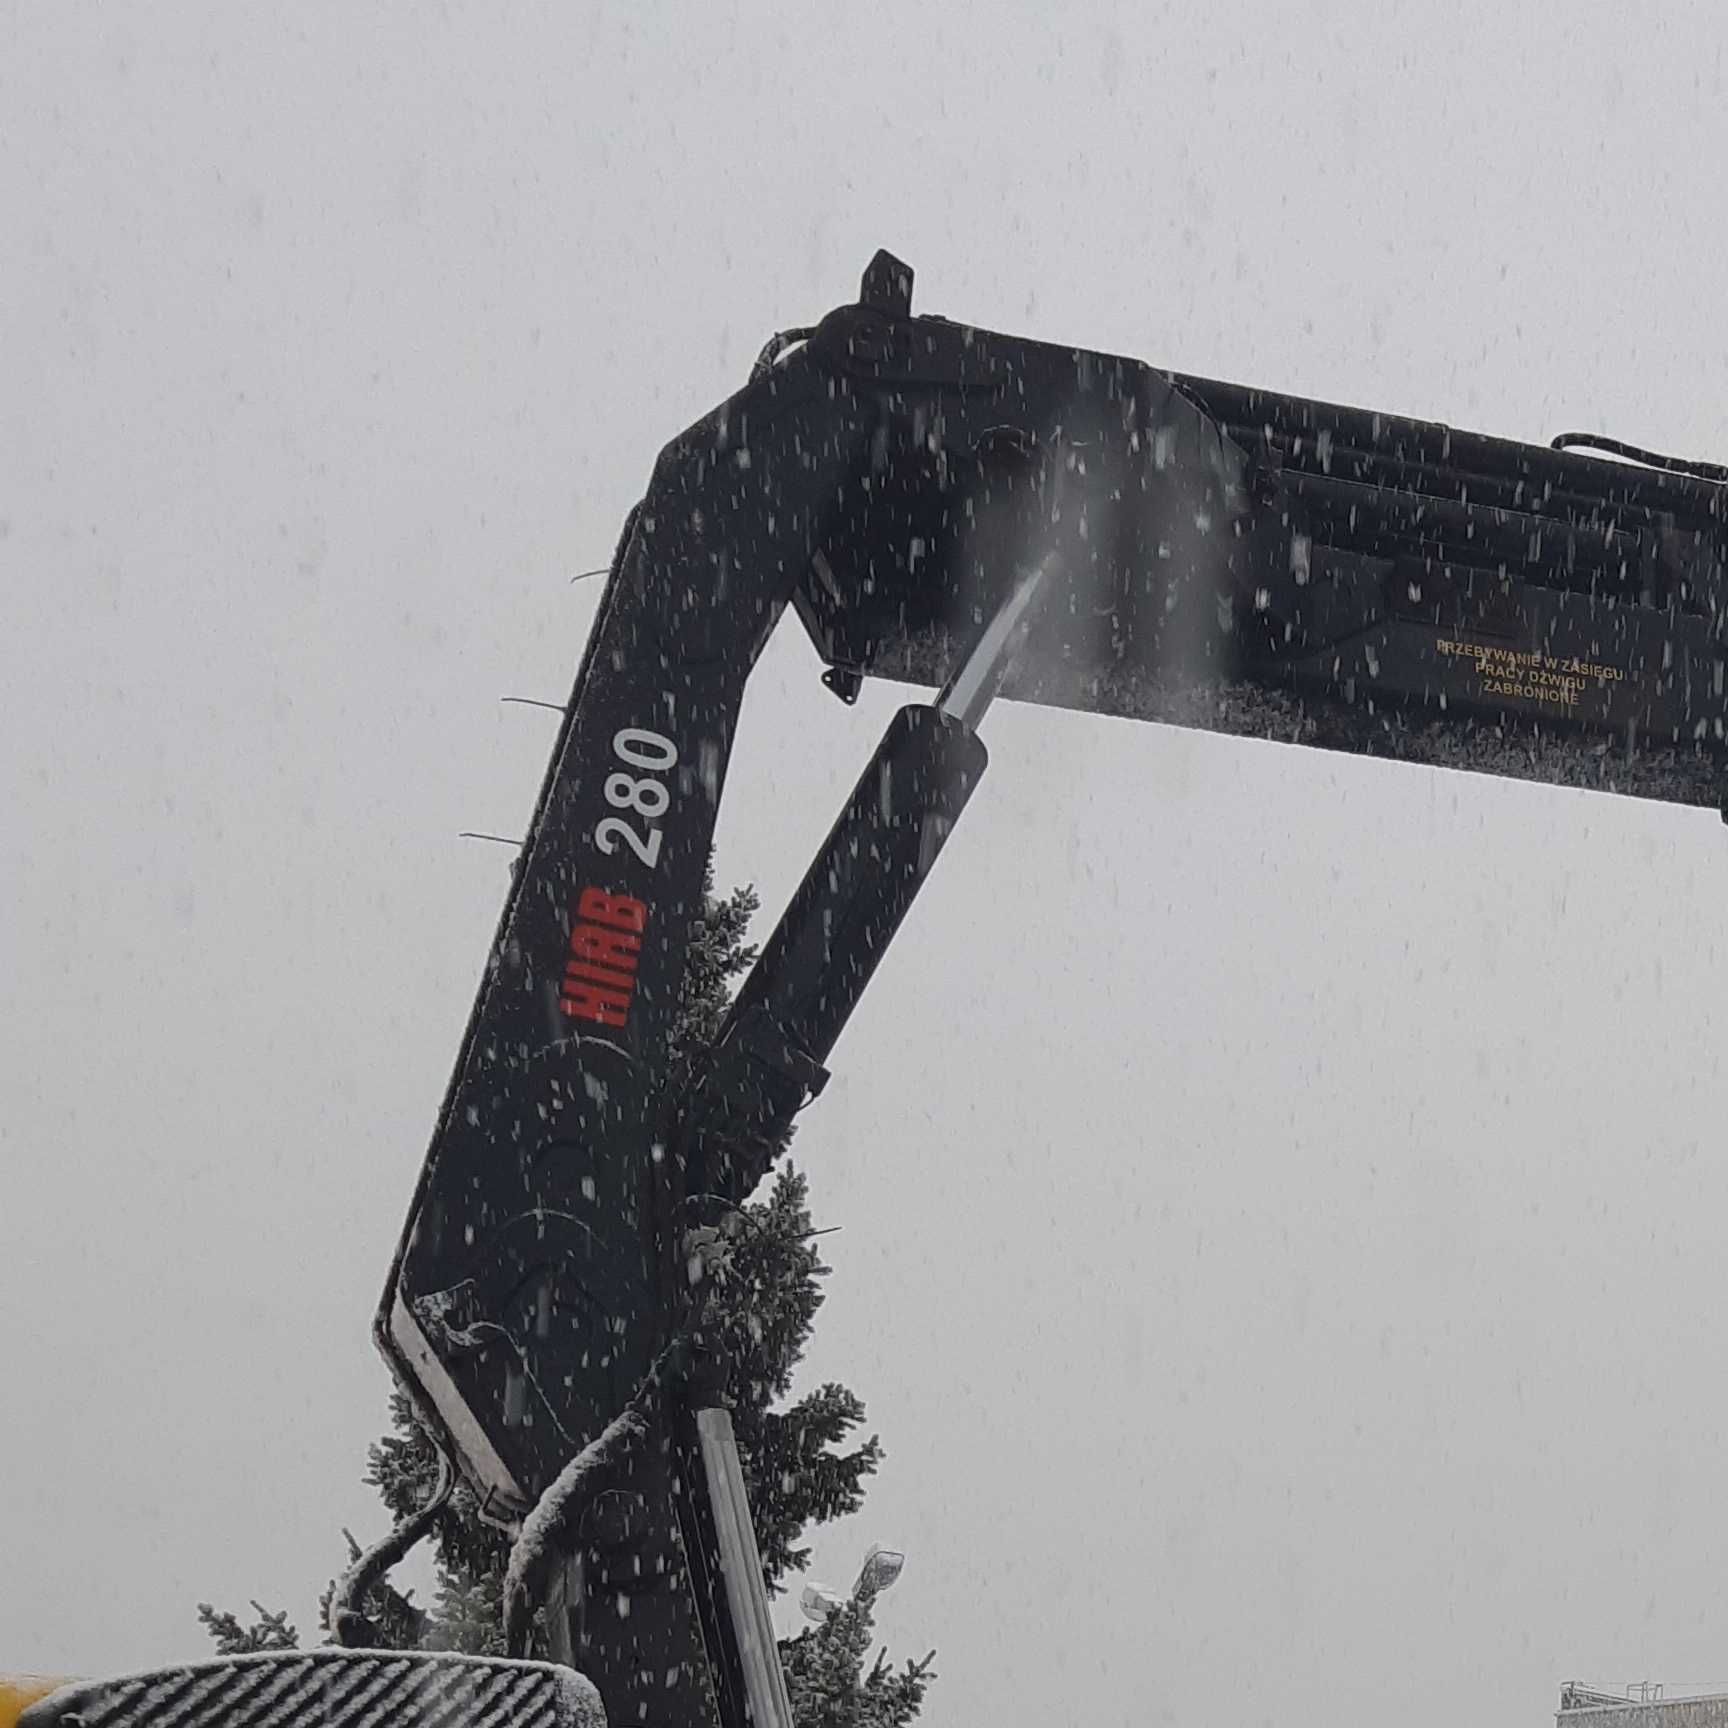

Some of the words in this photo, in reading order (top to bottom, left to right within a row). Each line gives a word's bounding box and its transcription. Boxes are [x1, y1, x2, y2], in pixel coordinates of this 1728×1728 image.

[1436, 639, 1540, 667] PRZEBYWANIE
[1544, 656, 1557, 670] W
[1475, 662, 1523, 681] PRACY
[1484, 679, 1580, 706] ZABRONIONE
[595, 728, 678, 869] 280
[560, 886, 648, 1029] HIAB
